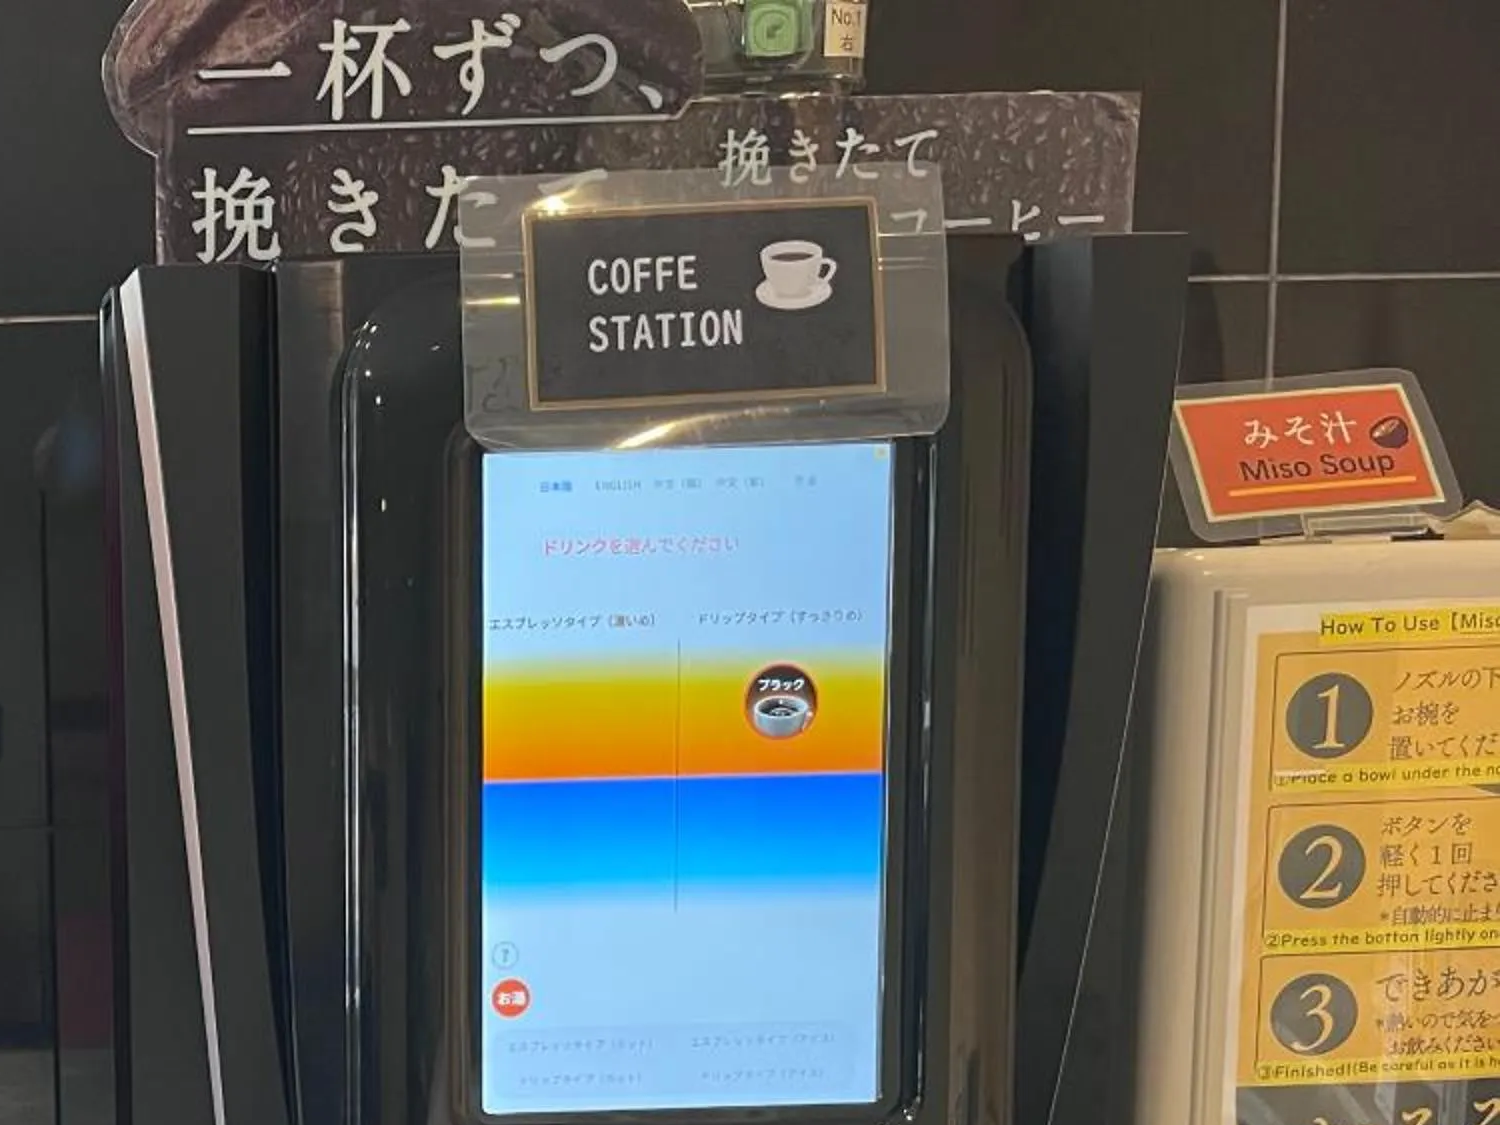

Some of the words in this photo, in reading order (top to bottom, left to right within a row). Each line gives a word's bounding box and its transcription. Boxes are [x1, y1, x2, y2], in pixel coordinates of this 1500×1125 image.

[197, 12, 672, 121] 一杯ずつ、
[719, 127, 939, 188] 挽きたて
[587, 254, 698, 296] COFFE
[588, 308, 744, 353] STATION
[1243, 410, 1358, 449] みそ汁
[1239, 457, 1313, 483] Miso
[1320, 451, 1396, 478] Soup
[1320, 620, 1364, 636] How
[1371, 617, 1397, 633] To
[1403, 614, 1440, 632] Use
[757, 677, 805, 693] ブラック
[1312, 684, 1345, 749] 1
[1359, 766, 1396, 783] bowl
[1402, 764, 1448, 780] under
[1456, 763, 1481, 779] the
[1381, 812, 1472, 837] ボタンを
[1300, 835, 1344, 900] 2
[1333, 929, 1359, 945] the
[1425, 927, 1475, 945] lightly
[1291, 984, 1334, 1050] 3
